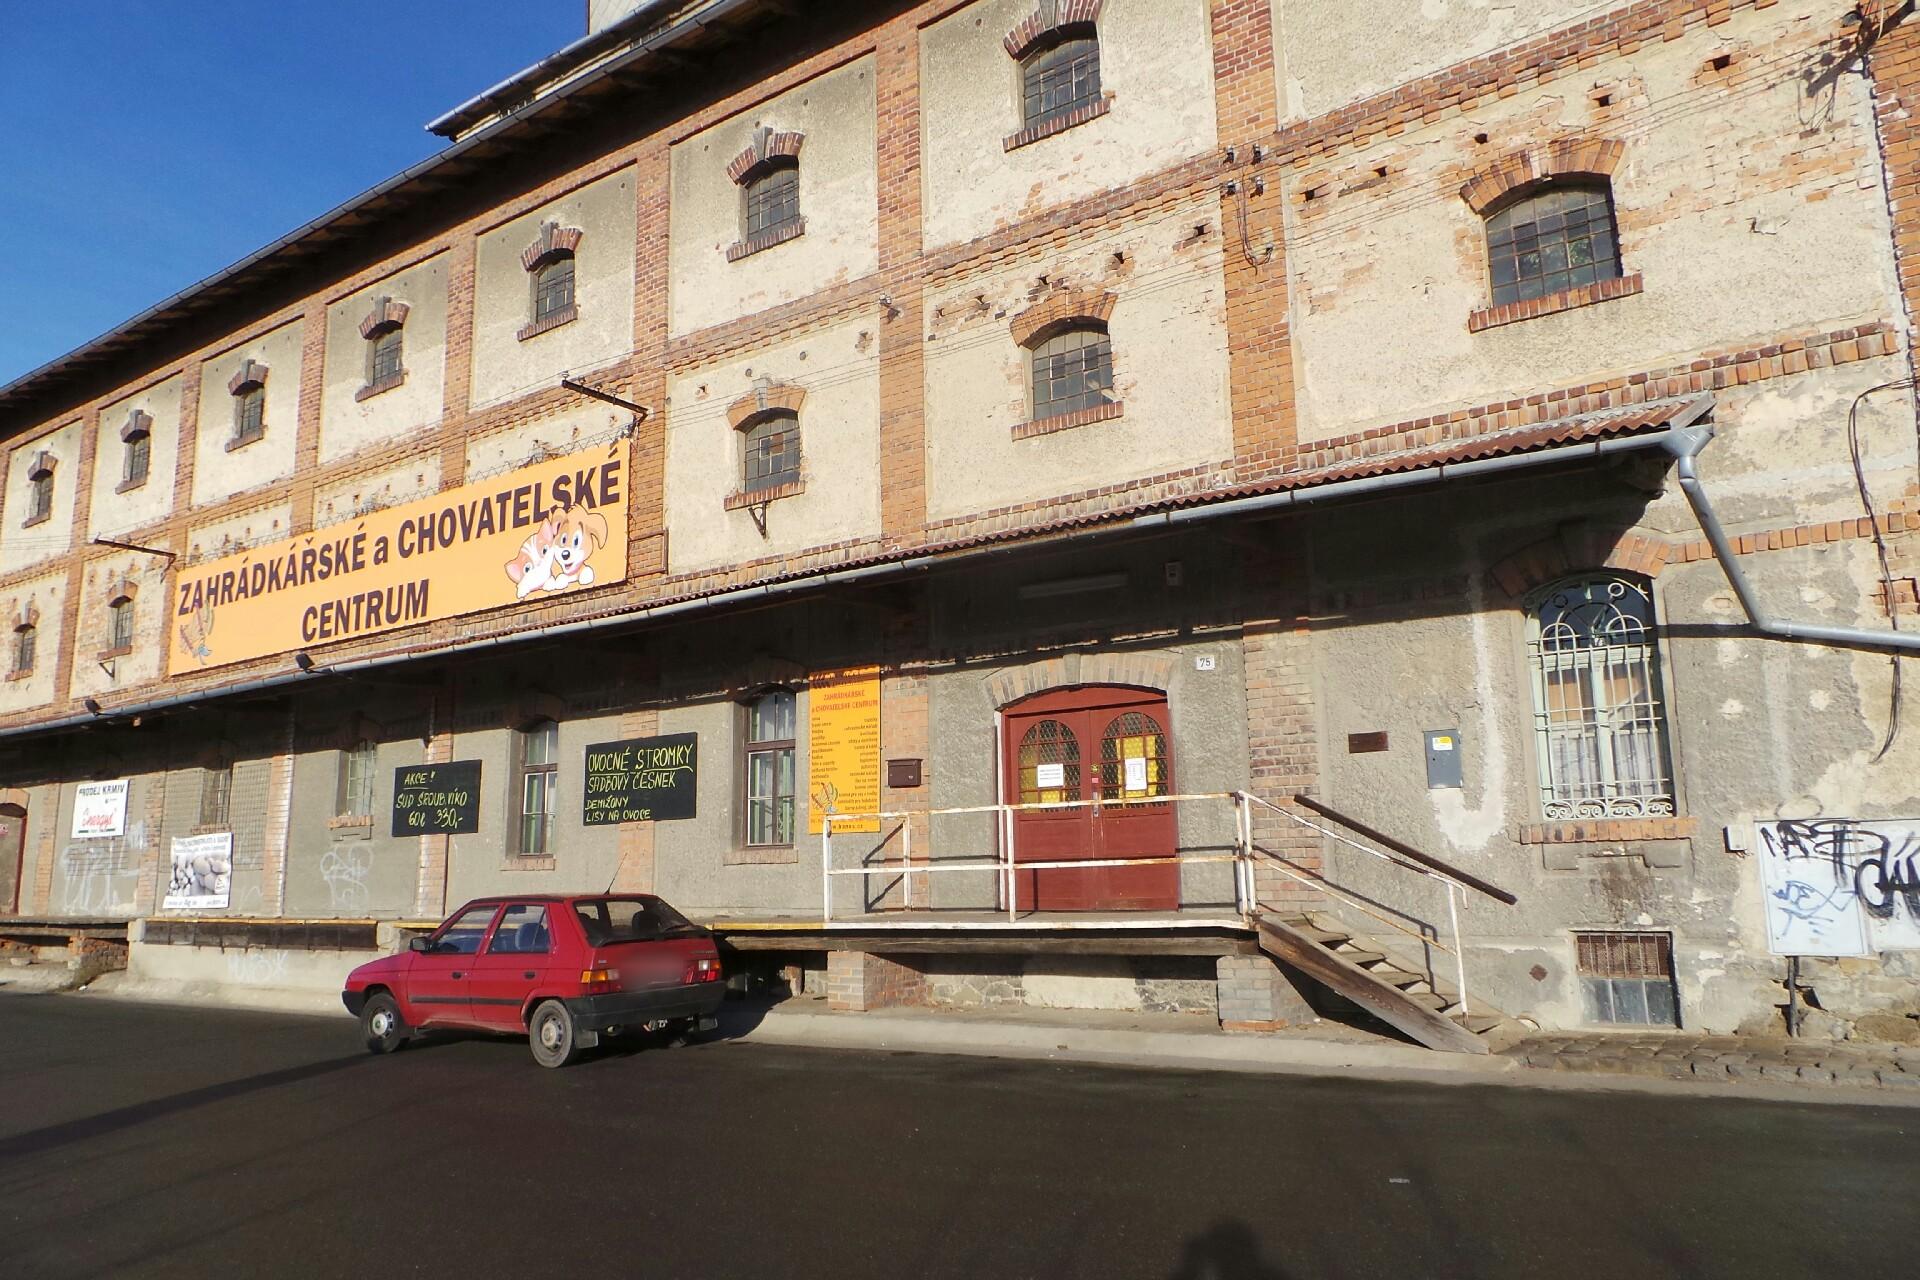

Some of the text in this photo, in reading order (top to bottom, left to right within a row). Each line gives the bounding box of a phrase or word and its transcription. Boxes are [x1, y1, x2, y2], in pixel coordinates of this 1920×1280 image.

[178, 449, 622, 616] ZAHRÁDKÁŘSKÉ a CHOVATELSKÉ
[302, 580, 429, 642] CENTRUM
[1199, 658, 1211, 668] 75
[588, 744, 693, 772] OVOCNÉ STROMKY
[585, 795, 629, 810] DEMIŽONY
[608, 810, 619, 821] NA
[623, 809, 651, 820] OVOCE
